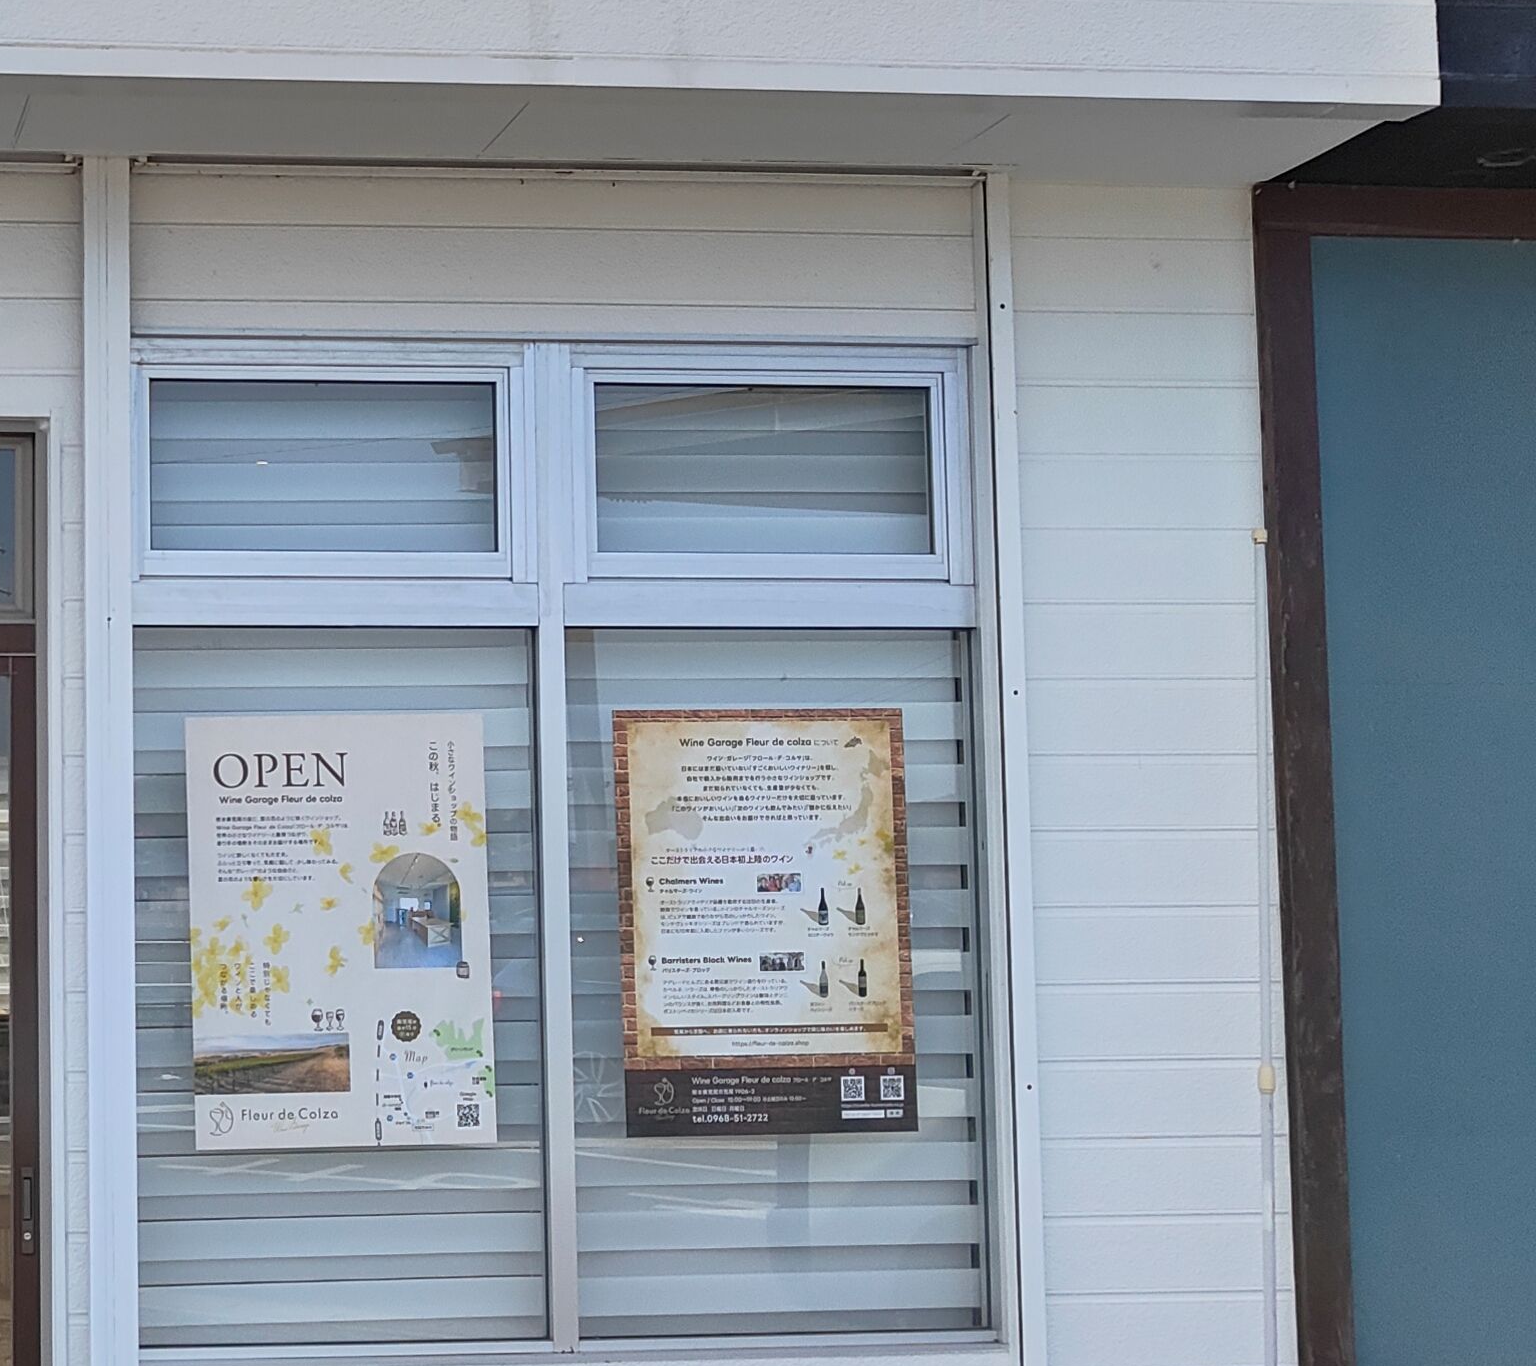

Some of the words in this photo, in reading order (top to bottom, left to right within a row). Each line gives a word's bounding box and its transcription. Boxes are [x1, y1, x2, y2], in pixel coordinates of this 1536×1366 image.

[679, 738, 704, 747] Wine
[707, 738, 743, 749] Garage
[746, 737, 770, 746] Fleur
[772, 737, 784, 746] de
[786, 737, 812, 746] colza
[213, 752, 349, 790] OPEN
[219, 796, 242, 804] Wine
[245, 795, 279, 805] Garage
[281, 795, 303, 803] Fleur
[306, 795, 317, 803] de
[319, 794, 343, 803] colza
[651, 855, 794, 865] ここだけで出会える日本初上陸のワイン
[658, 877, 697, 885] Chalmers
[699, 877, 724, 885] Wines
[661, 956, 701, 964] Barristers
[703, 956, 725, 964] Block
[727, 955, 752, 963] Wines
[404, 1051, 428, 1064] Map
[691, 1076, 710, 1085] Wine
[712, 1076, 739, 1086] Garage
[741, 1076, 759, 1084] Fleur
[760, 1076, 770, 1084] de
[772, 1075, 791, 1084] colza
[241, 1108, 274, 1121] Fleur
[278, 1108, 295, 1120] de
[298, 1107, 339, 1120] Colza
[692, 1113, 769, 1124] tel.0968-51-2722
